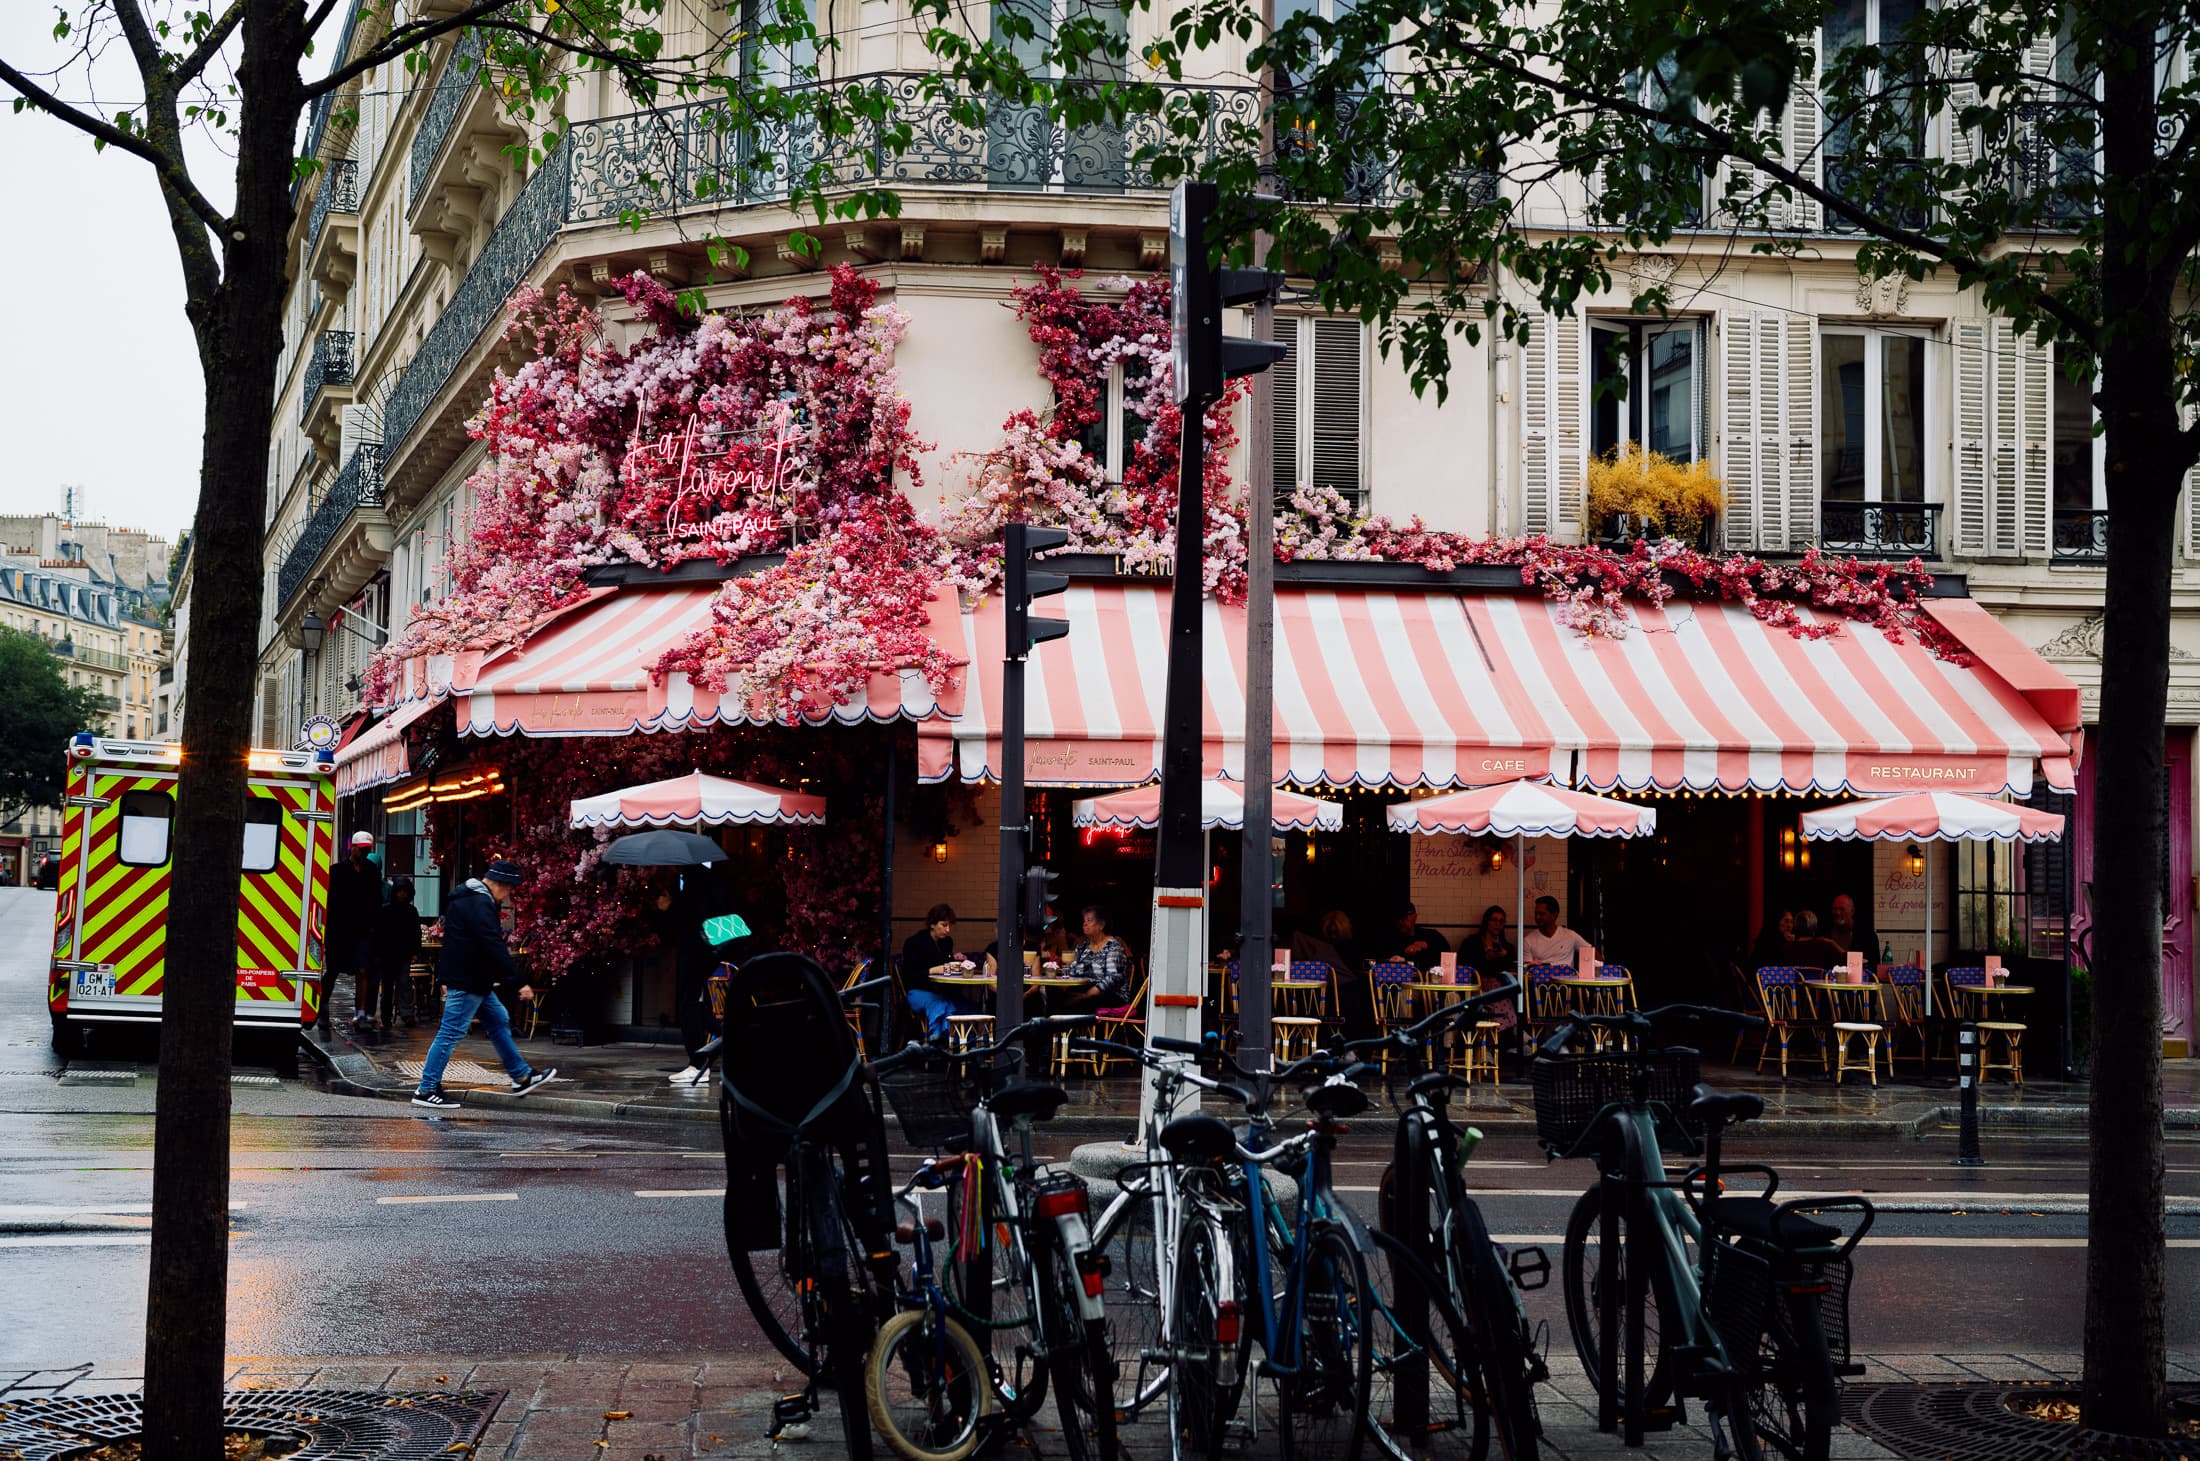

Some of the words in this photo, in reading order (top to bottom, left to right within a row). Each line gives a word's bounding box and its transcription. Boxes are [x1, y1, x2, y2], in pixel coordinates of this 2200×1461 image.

[678, 516, 777, 538] SAINT-PAUL
[1114, 555, 1132, 575] LA
[1088, 757, 1136, 766] SAINT-PAUL
[1481, 759, 1526, 771] CAFE
[1870, 766, 1977, 779] RESTAURANT
[1415, 838, 1446, 857] Porn
